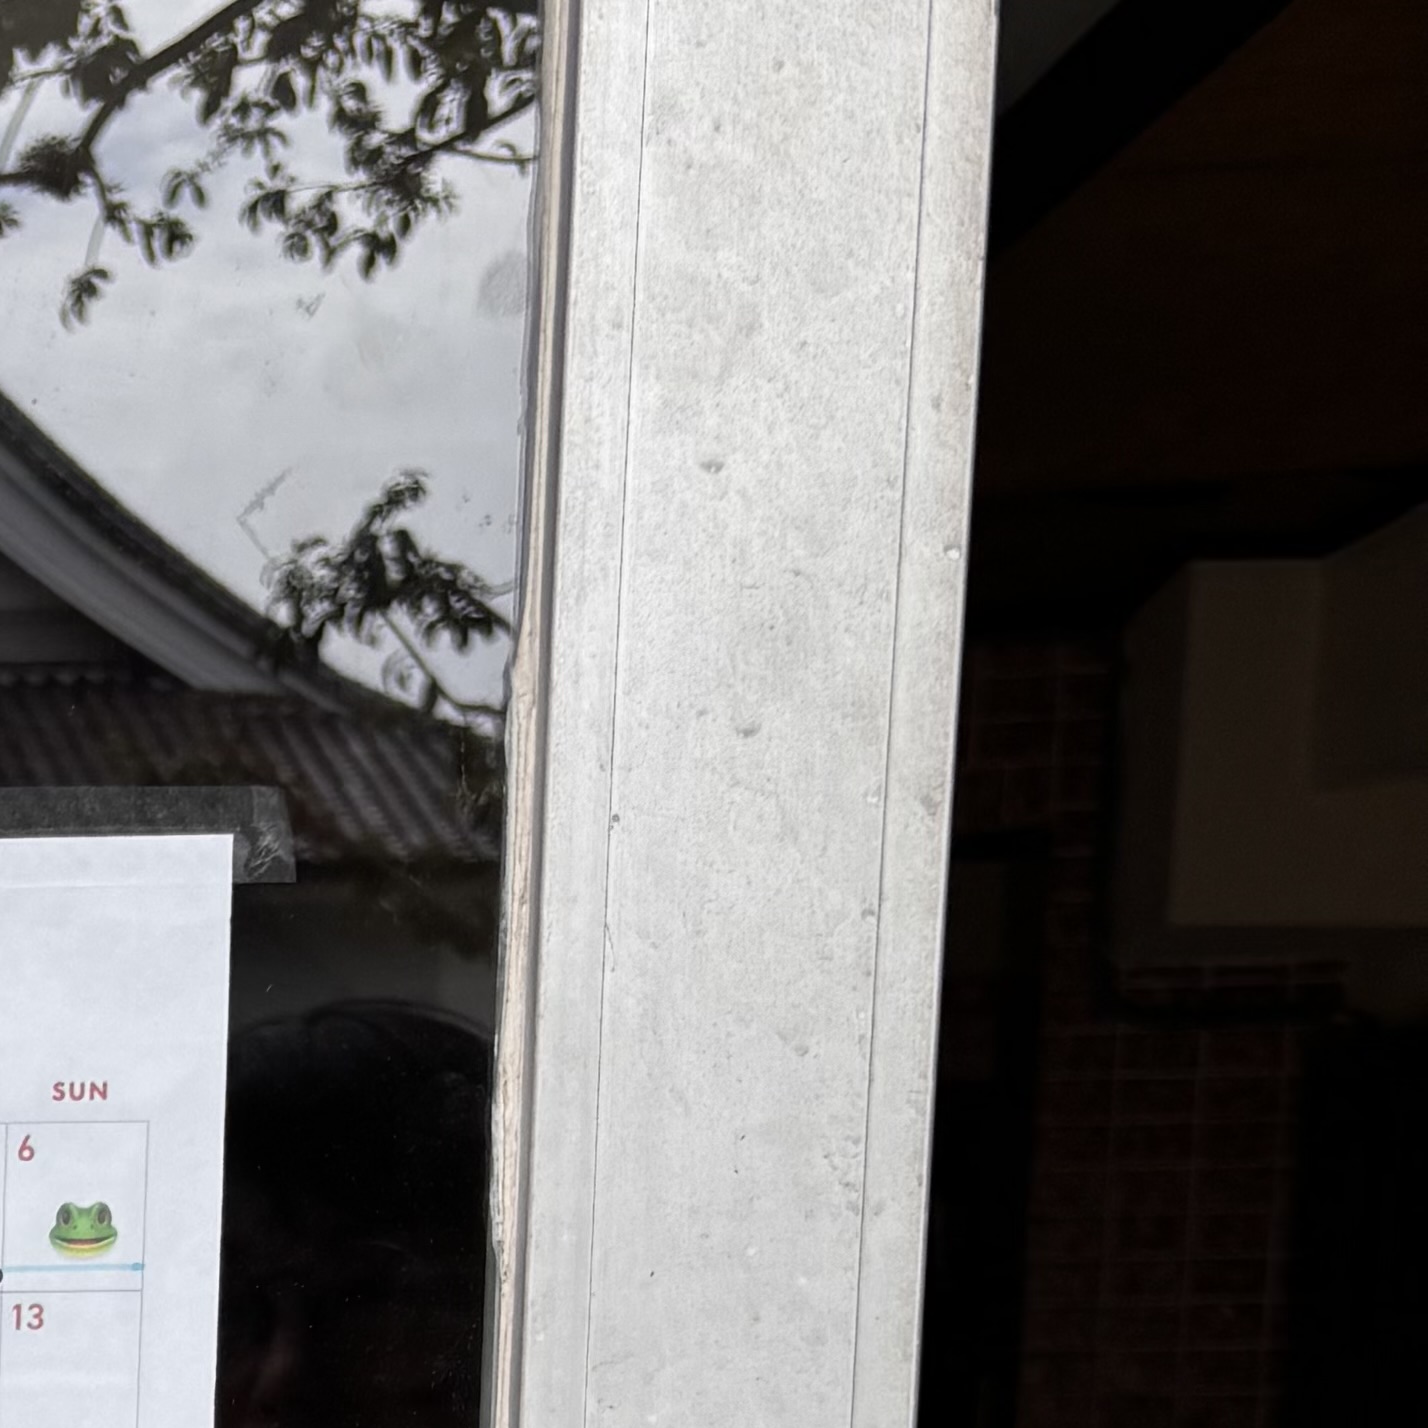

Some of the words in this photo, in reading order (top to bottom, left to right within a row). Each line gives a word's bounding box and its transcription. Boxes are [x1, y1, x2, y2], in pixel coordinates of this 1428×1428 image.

[51, 1081, 108, 1102] SUN
[17, 1134, 36, 1162] 6
[12, 1303, 45, 1331] 13
